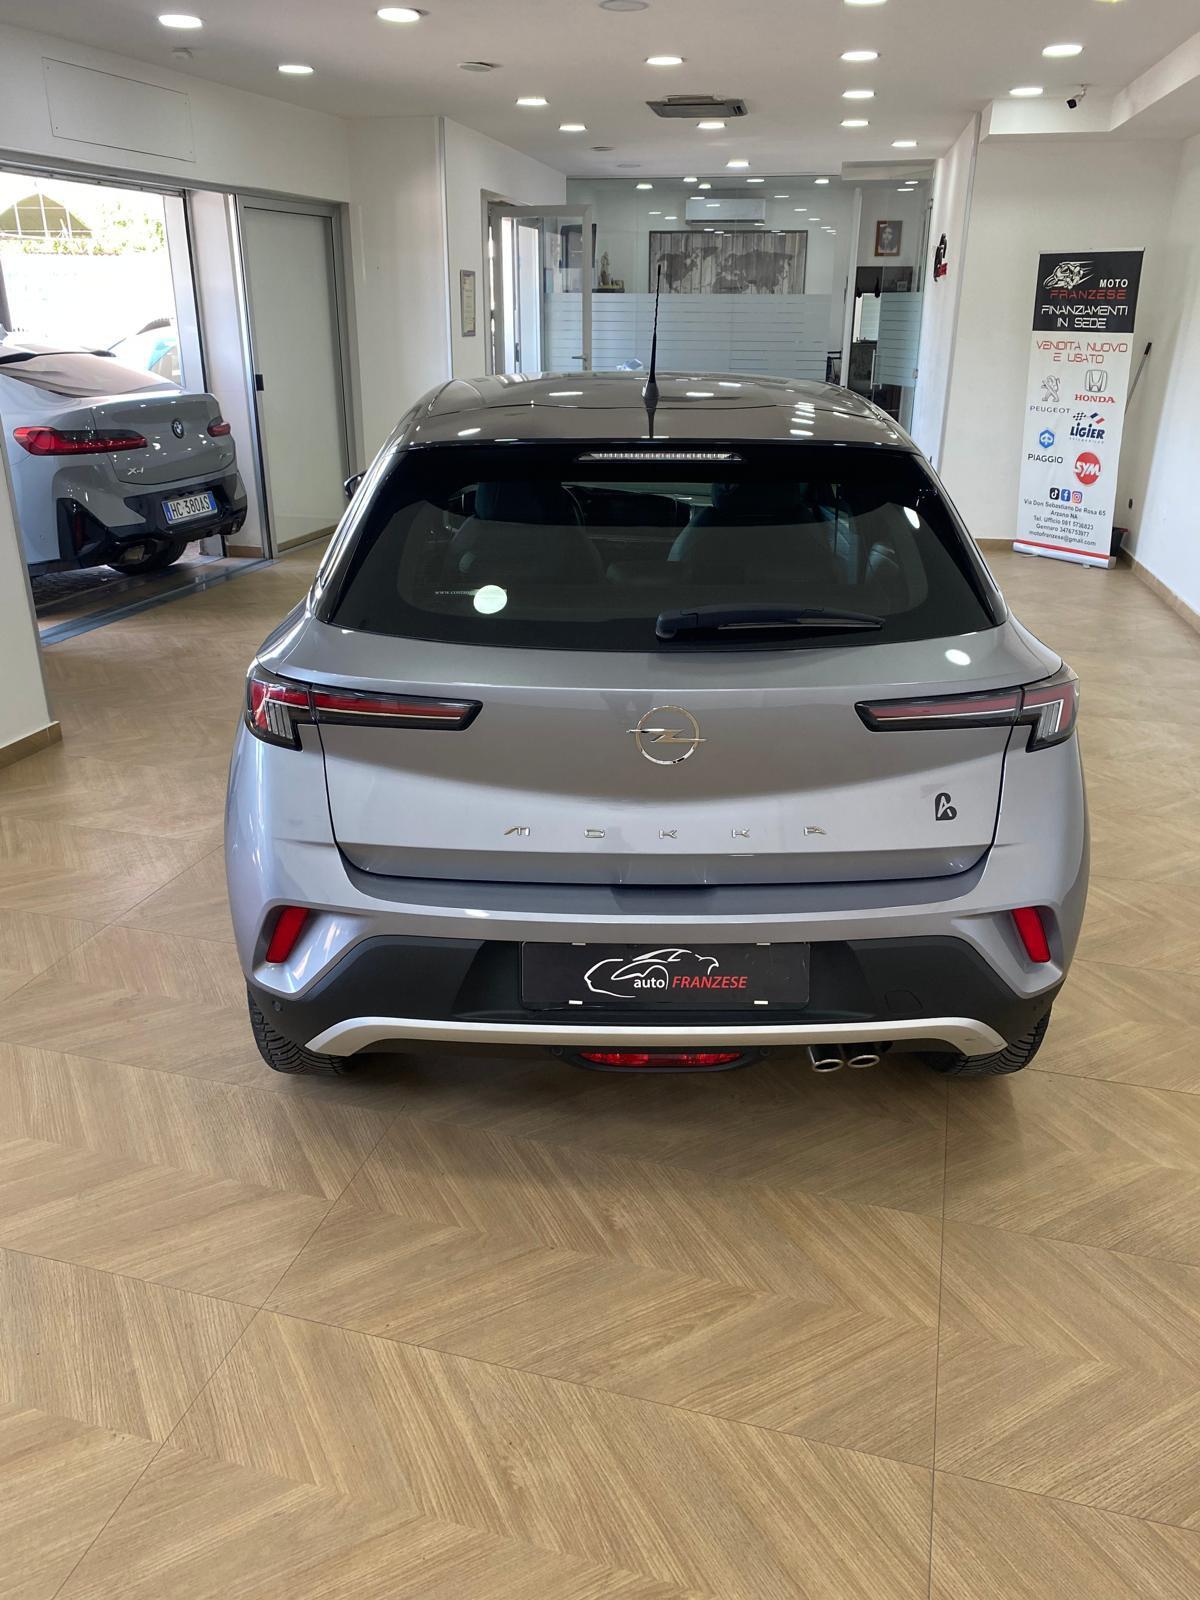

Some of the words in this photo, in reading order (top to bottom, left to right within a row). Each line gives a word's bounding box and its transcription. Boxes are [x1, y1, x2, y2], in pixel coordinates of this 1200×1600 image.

[1099, 278, 1129, 288] MOTO
[1049, 289, 1127, 300] FRANZESE
[1041, 305, 1128, 316] FINANZIAMENTI
[1056, 317, 1069, 328] IN
[1074, 317, 1107, 329] SEDE
[1036, 340, 1081, 351] VENDITA
[1086, 342, 1128, 353] NUOVO
[1053, 352, 1061, 362] E
[1067, 353, 1104, 364] USATO
[1074, 393, 1116, 404] HONDA
[1029, 405, 1071, 414] PEUGEOT
[1027, 453, 1064, 464] PIAGGIO
[1074, 461, 1101, 477] SYM
[1045, 501, 1074, 512] Sebastiano
[1050, 510, 1069, 518] Arzano
[1043, 516, 1061, 525] Ufficio
[1036, 523, 1059, 532] Gennaro
[1028, 529, 1097, 546] motofranzese@gmail.com
[633, 976, 665, 989] auto
[671, 976, 748, 989] FRANZESE
